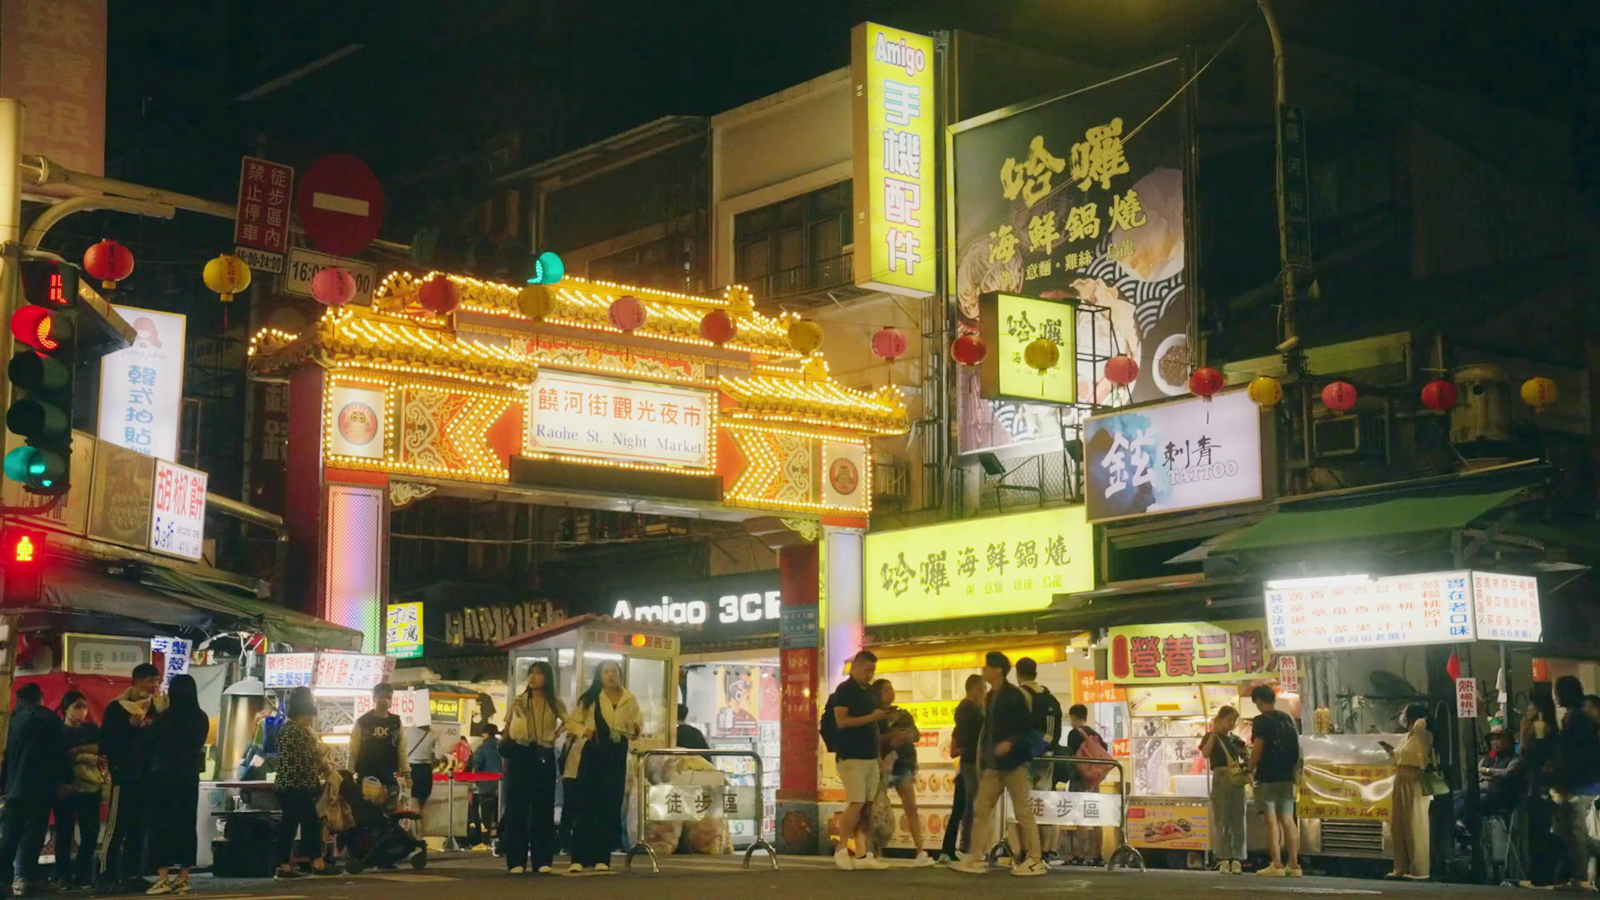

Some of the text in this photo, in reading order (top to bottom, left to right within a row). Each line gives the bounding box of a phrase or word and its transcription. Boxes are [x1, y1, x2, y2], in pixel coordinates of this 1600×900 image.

[875, 32, 925, 77] Amigo
[883, 79, 921, 275] 手機配件
[242, 163, 266, 242] 禁止停車
[265, 167, 287, 248] 徒步區內
[989, 188, 1147, 264] 海鮮鍋燒
[538, 387, 701, 427] 饒河街觀光夜市
[536, 424, 702, 454] Raohe St. Night Market
[1162, 435, 1221, 470] 刺青
[1168, 459, 1238, 486] TATTOO
[157, 466, 204, 521] 胡椒餅
[1446, 578, 1471, 636] 實在老口味
[312, 658, 349, 686] 胡椒餅
[401, 694, 415, 713] 65
[1458, 679, 1475, 716] 熱楊桃汁
[664, 793, 739, 814] 徒步區
[1029, 798, 1100, 819] 徒步區
